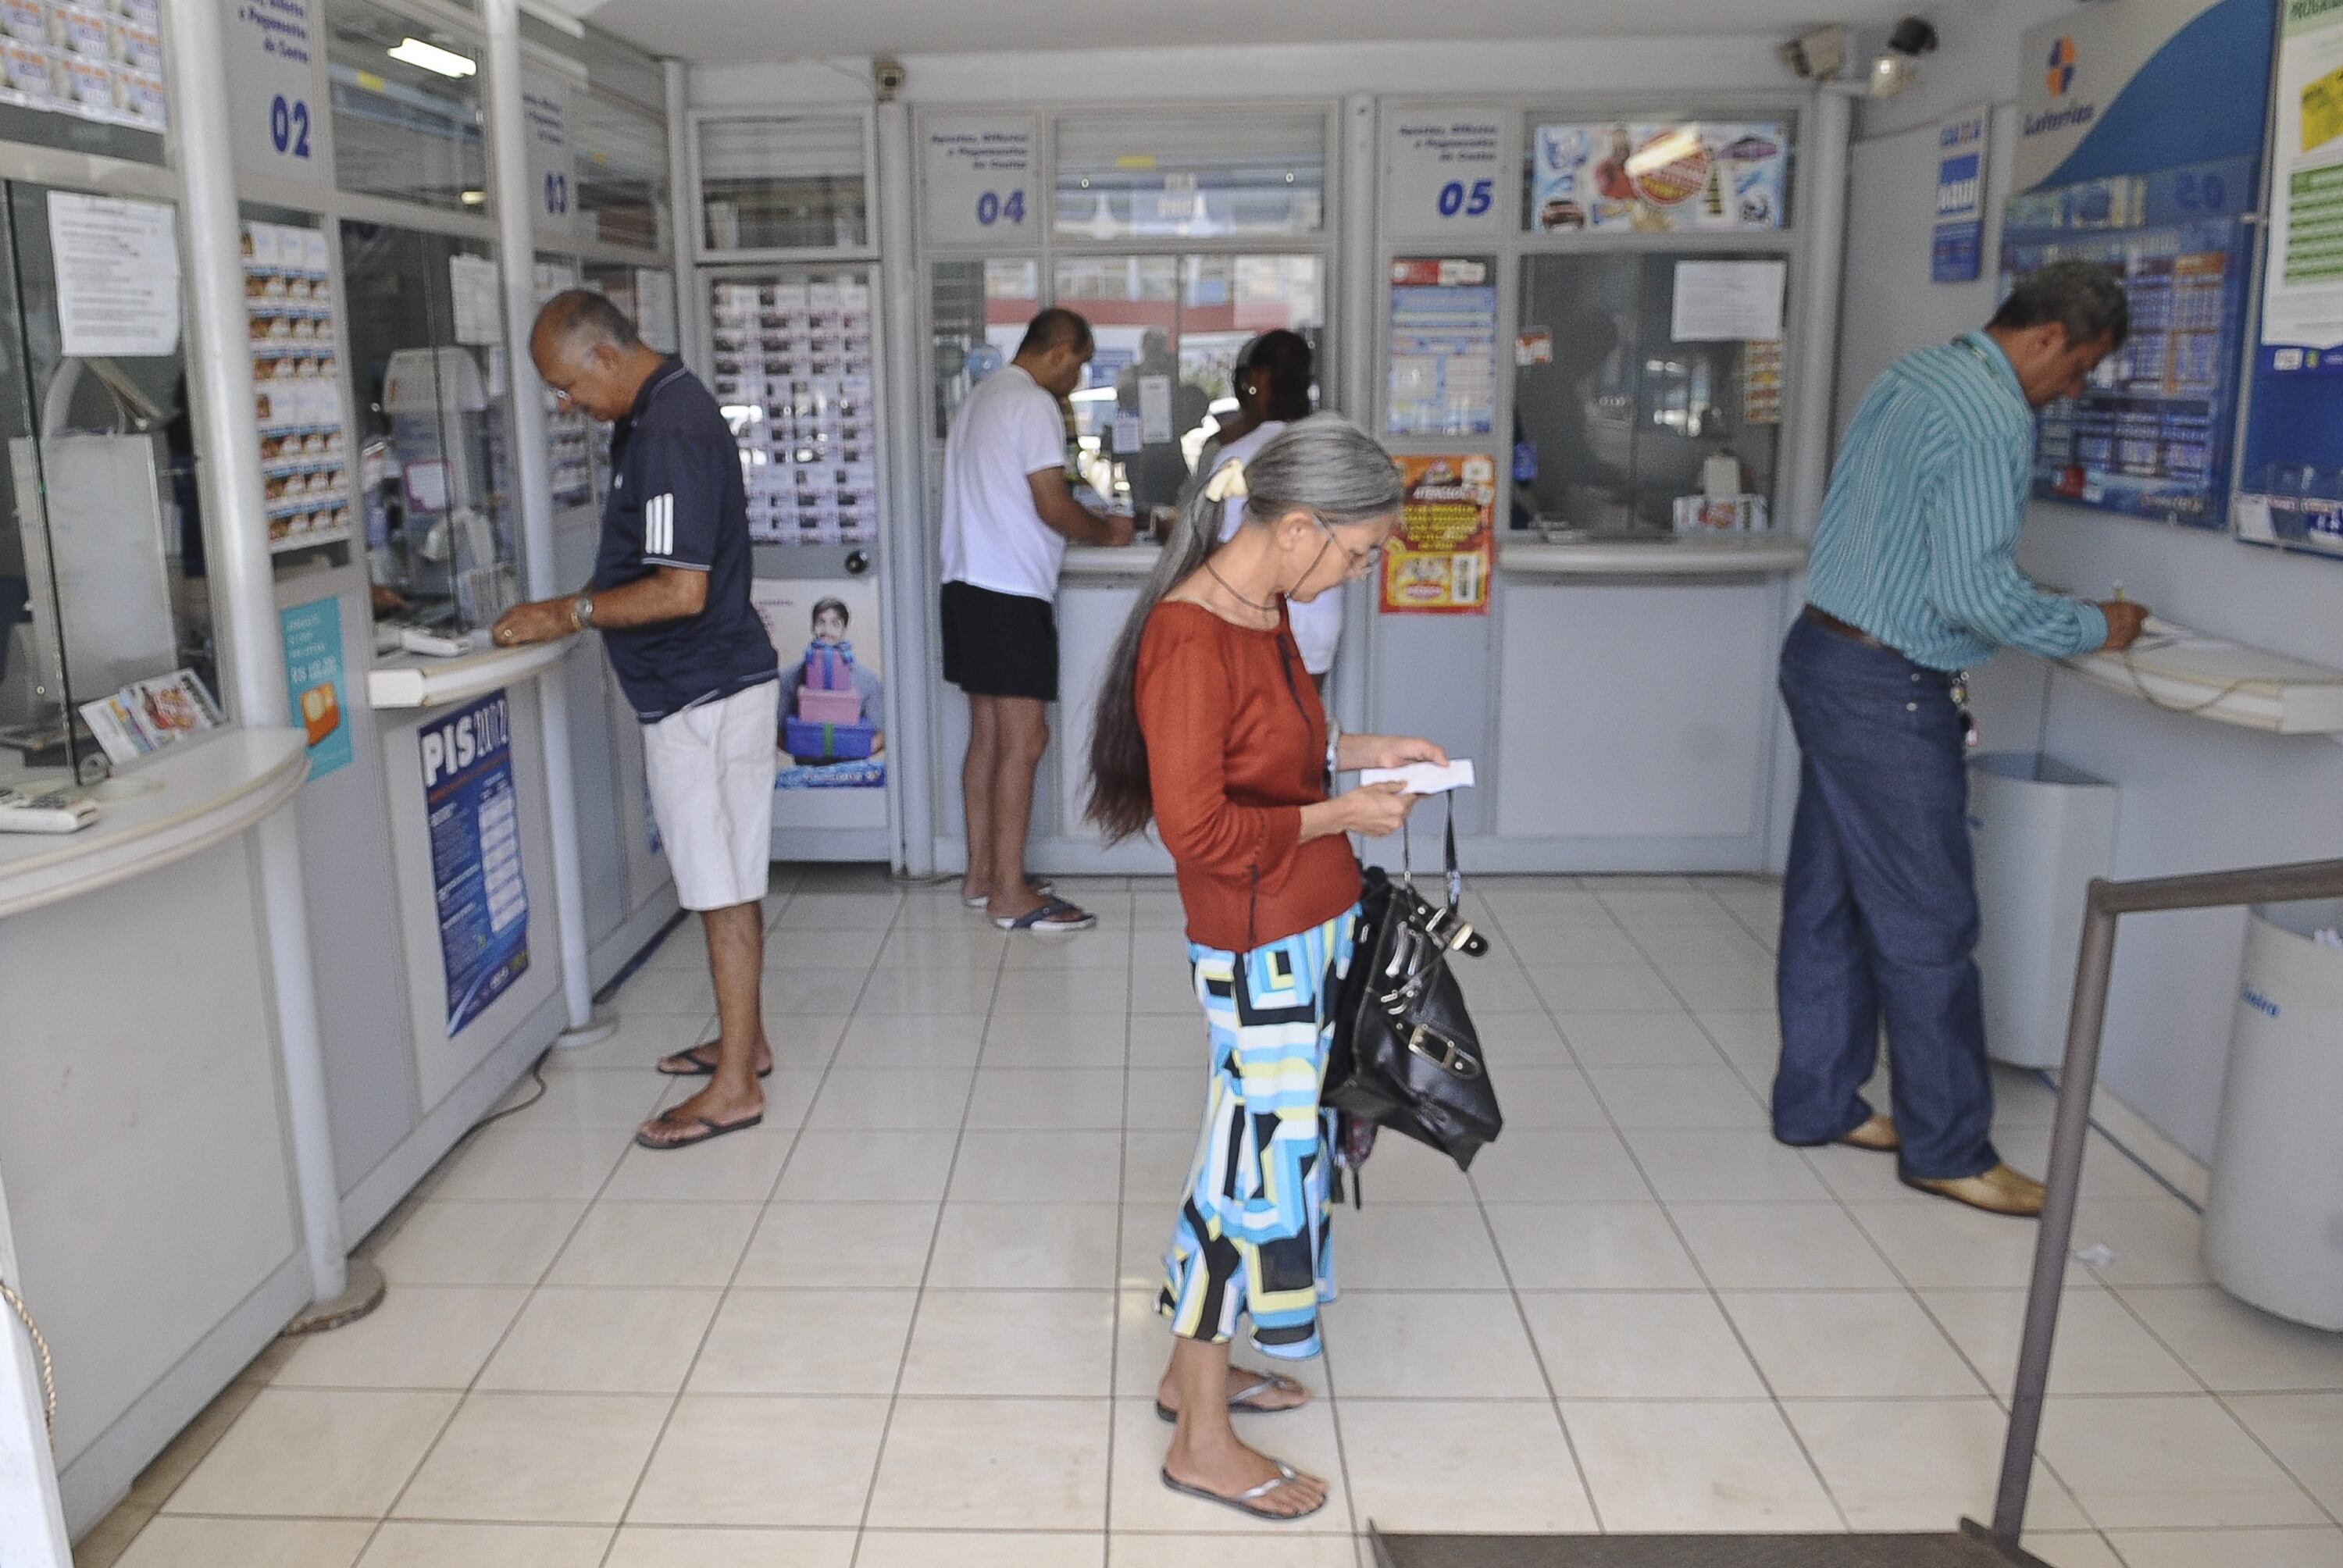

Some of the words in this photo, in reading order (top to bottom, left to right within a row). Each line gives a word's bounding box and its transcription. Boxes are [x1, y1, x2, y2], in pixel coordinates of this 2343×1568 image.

[271, 95, 309, 158] 02
[977, 189, 1026, 226] 04
[1437, 178, 1495, 218] 05
[420, 715, 476, 788] PIS
